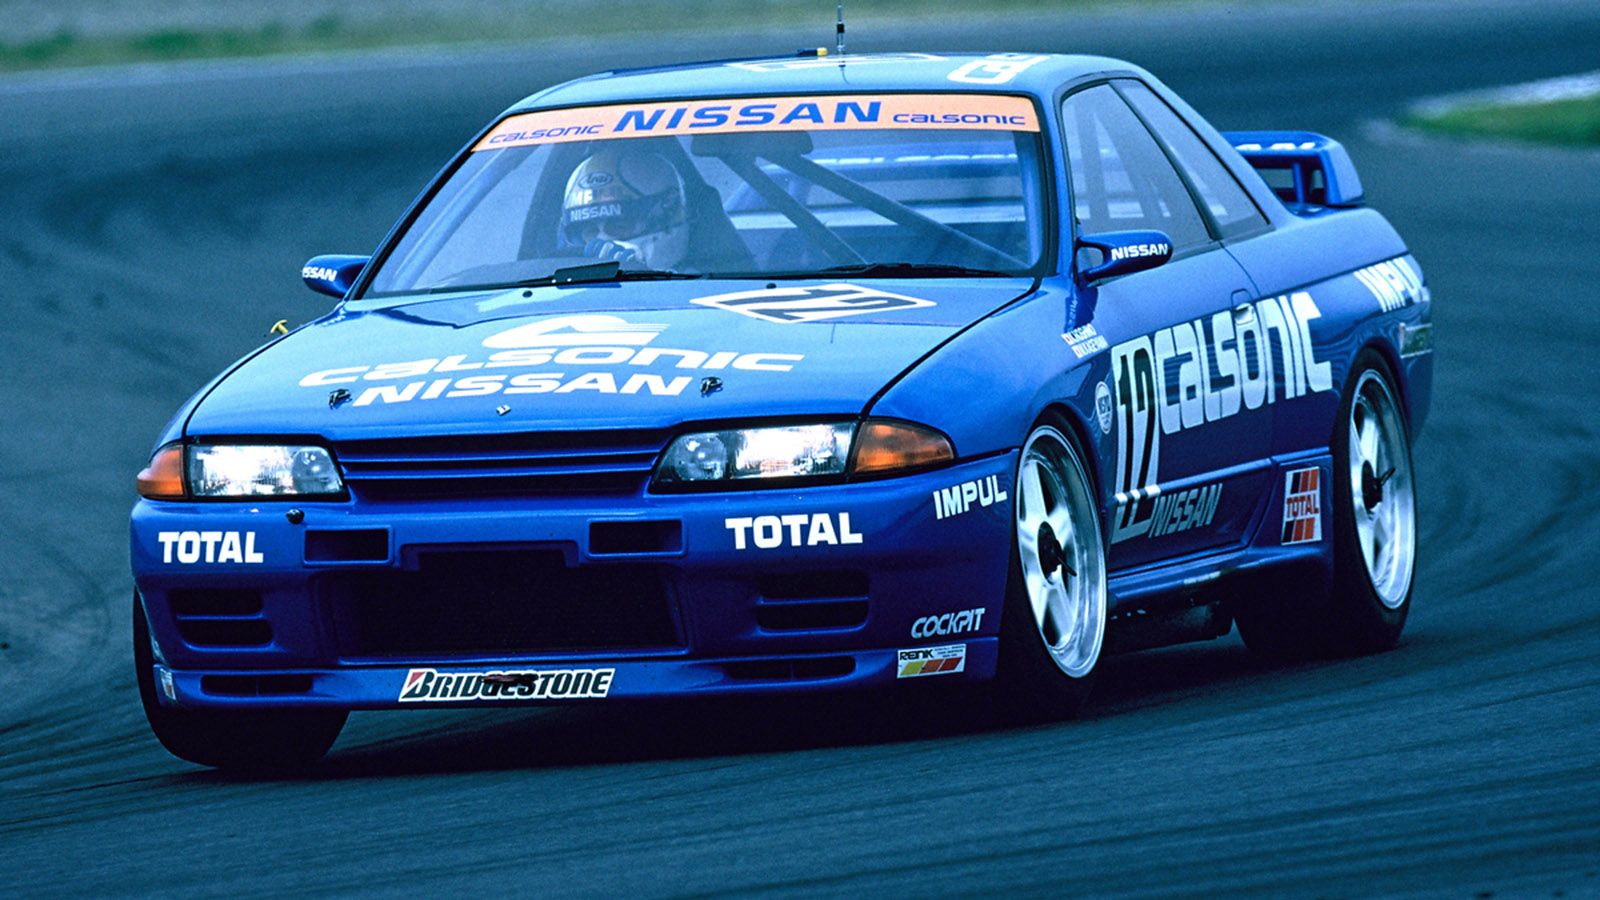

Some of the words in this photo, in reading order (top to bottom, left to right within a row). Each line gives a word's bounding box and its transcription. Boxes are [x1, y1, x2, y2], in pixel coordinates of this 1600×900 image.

[612, 101, 882, 132] NISSAN
[570, 203, 621, 222] NISSAN
[1111, 243, 1169, 261] NISSAN
[352, 372, 692, 408] NISSAN
[1118, 347, 1156, 530] 12
[933, 475, 1008, 520] IMPUL
[1148, 482, 1223, 539] NISSAN
[1286, 492, 1320, 518] TOTAL
[725, 511, 863, 550] TOTAL
[158, 531, 264, 563] TOTAL
[910, 607, 985, 639] COCKPIT
